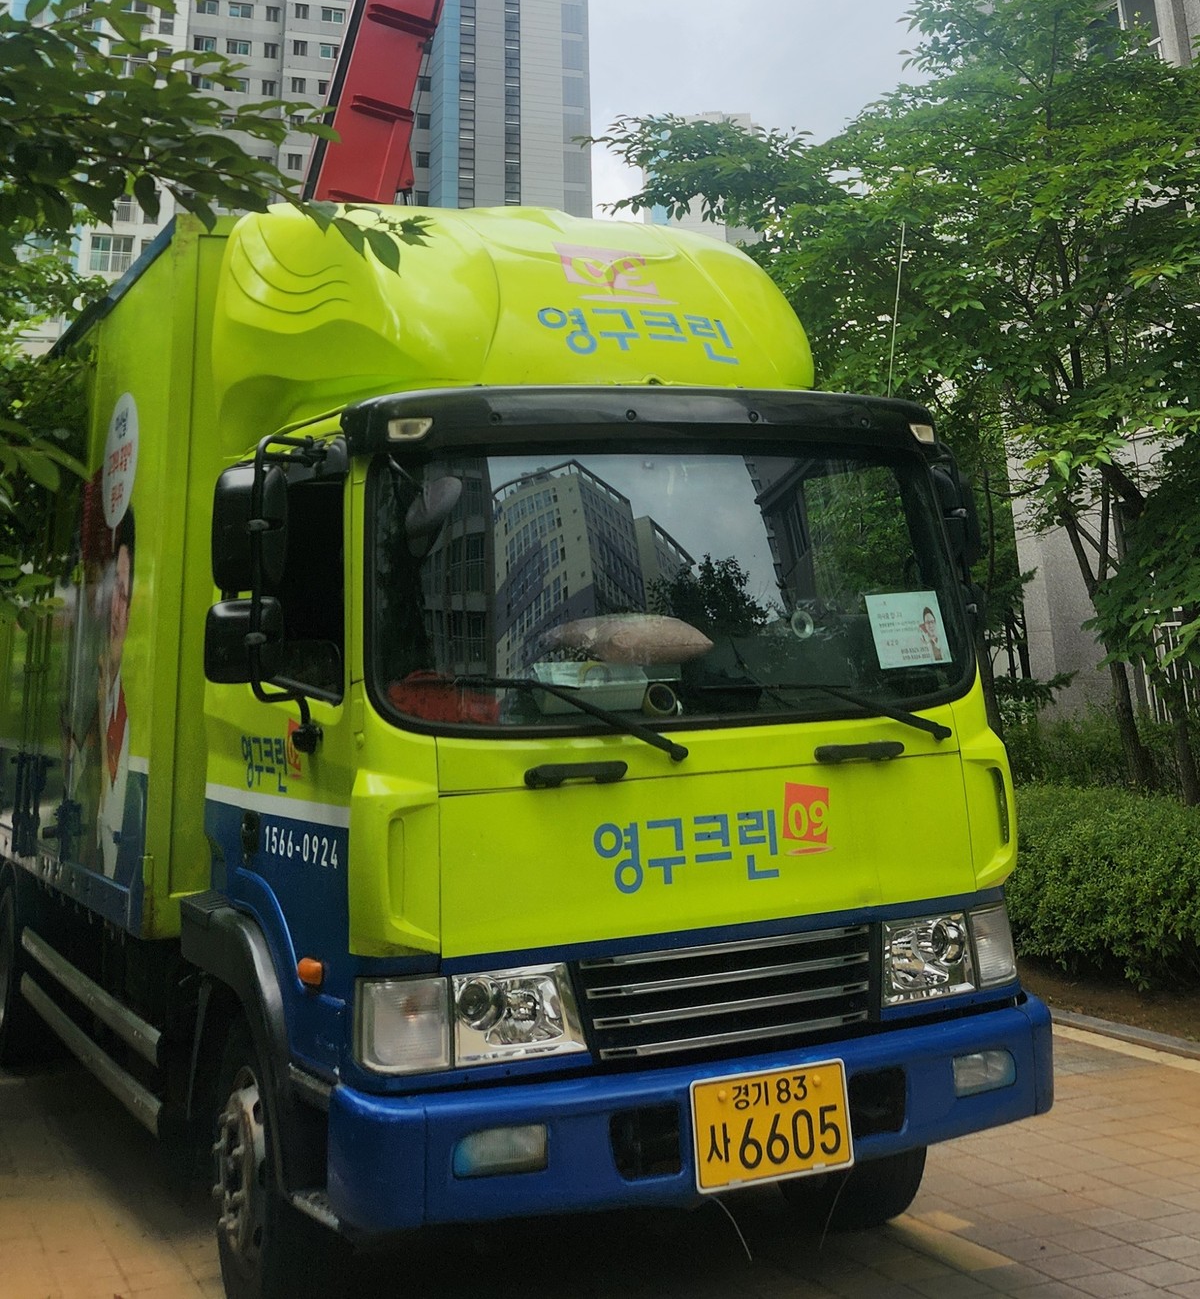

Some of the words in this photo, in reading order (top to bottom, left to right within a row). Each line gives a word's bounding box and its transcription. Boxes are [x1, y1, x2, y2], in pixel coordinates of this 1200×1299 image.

[537, 307, 740, 365] 영구크린
[241, 734, 288, 793] 영구크린
[265, 825, 338, 869] 1566-0924
[593, 809, 780, 894] 영구크린
[788, 800, 830, 838] 09
